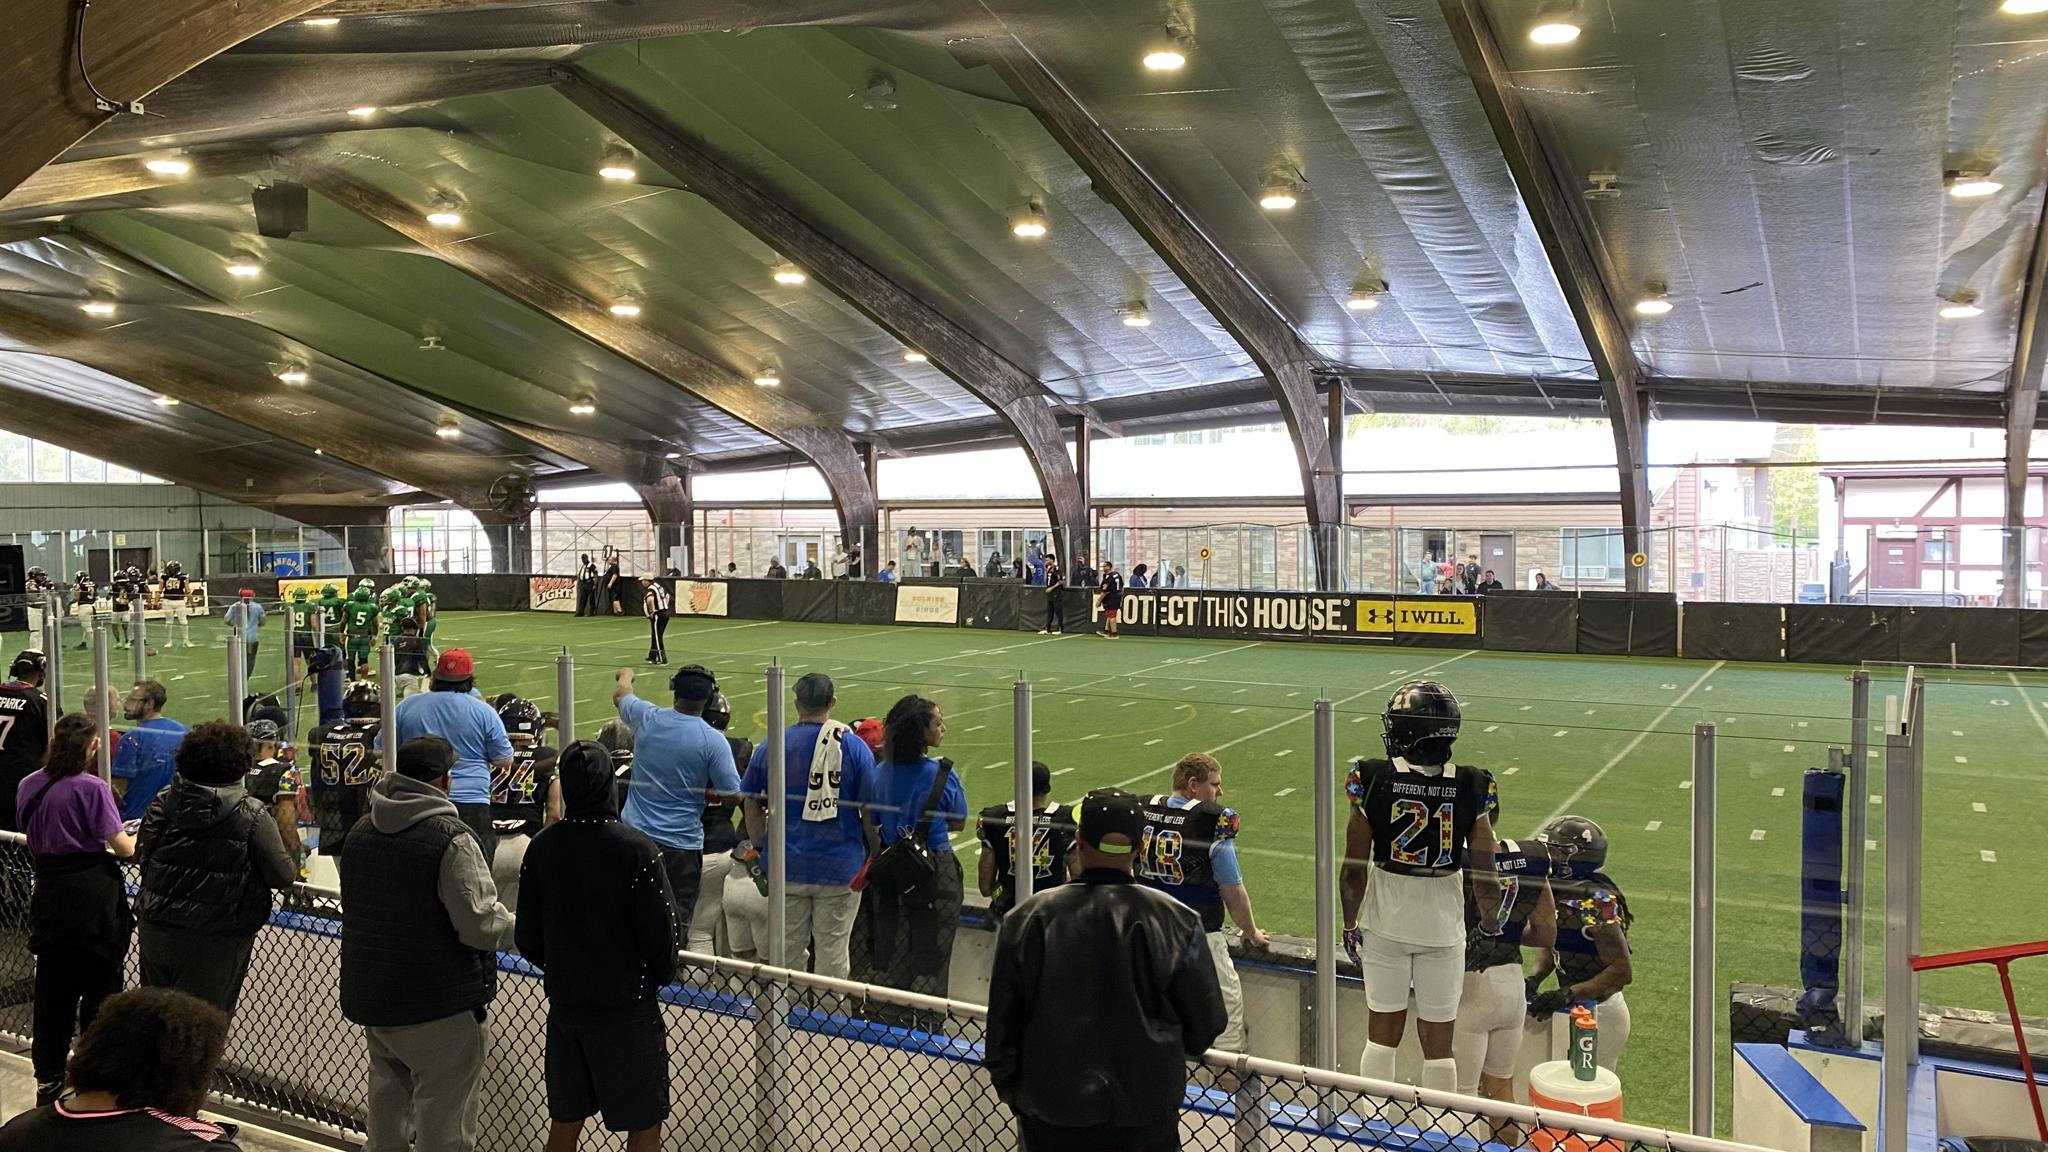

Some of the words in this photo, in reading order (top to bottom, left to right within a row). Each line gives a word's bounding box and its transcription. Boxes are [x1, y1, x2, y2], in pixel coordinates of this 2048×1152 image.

[536, 588, 574, 607] LIGHT
[355, 612, 367, 626] 5
[1203, 597, 1248, 628] THIS
[1401, 610, 1408, 624] I
[1410, 610, 1465, 626] WILL.
[320, 742, 367, 786] 52
[1392, 782, 1427, 796] DIFFERENT,
[1428, 786, 1441, 797] NOT
[1441, 787, 1457, 798] LESS
[1390, 798, 1454, 868] 21
[1581, 828, 1593, 843] 4
[1139, 824, 1184, 886] 18
[1502, 860, 1513, 871] NOT
[1513, 858, 1527, 869] LESS
[1579, 1036, 1593, 1052] G
[1582, 1052, 1593, 1069] R
